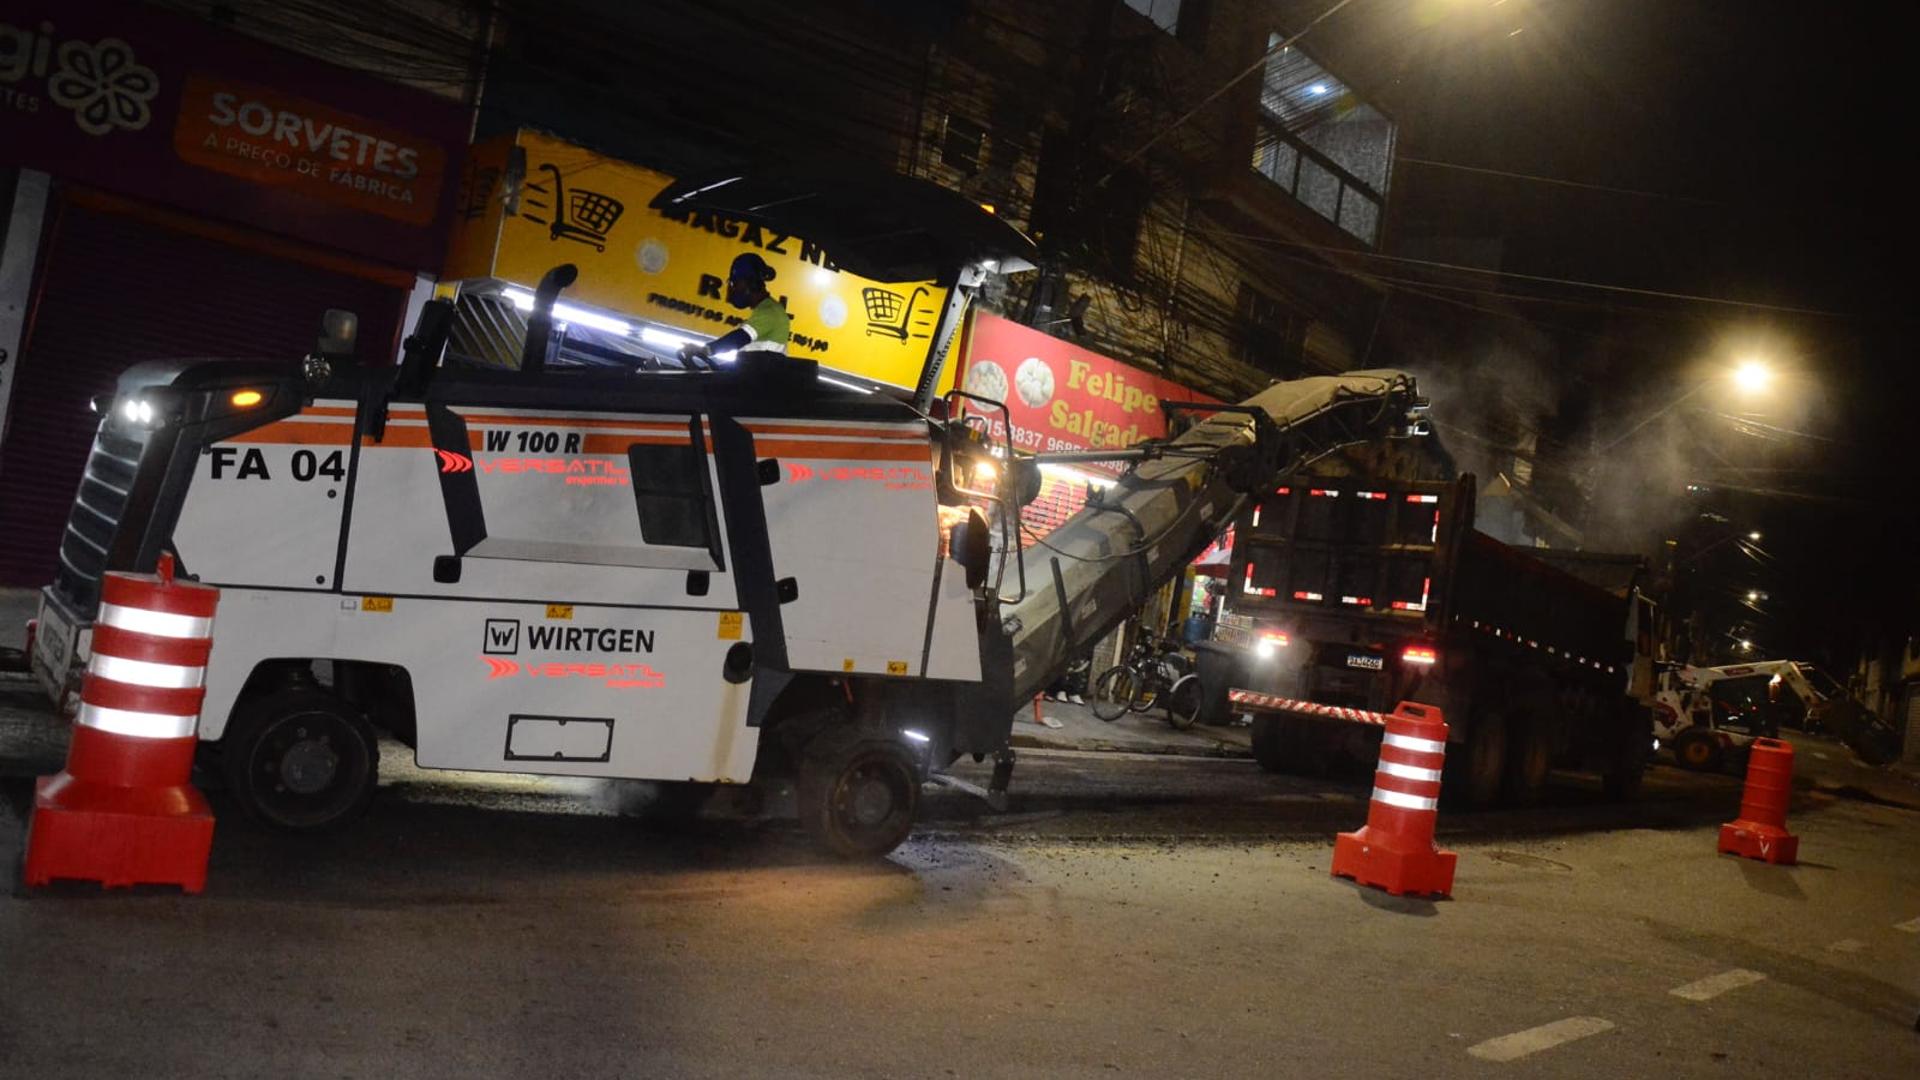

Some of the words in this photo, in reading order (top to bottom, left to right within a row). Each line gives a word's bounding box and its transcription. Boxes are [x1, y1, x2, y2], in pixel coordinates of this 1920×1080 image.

[208, 91, 419, 180] SORVETES
[203, 133, 217, 148] A
[226, 136, 291, 168] PREÇO
[297, 157, 321, 178] DE
[329, 165, 414, 205] FÁBRICA
[1066, 359, 1159, 413] Felipe
[487, 430, 511, 453] W
[517, 431, 560, 454] 100
[563, 431, 581, 454] R
[210, 447, 271, 481] FA
[290, 449, 346, 482] 04
[479, 458, 627, 475] VERSATIL
[527, 625, 655, 653] WIRTGEN
[526, 661, 665, 678] VERSATIL
